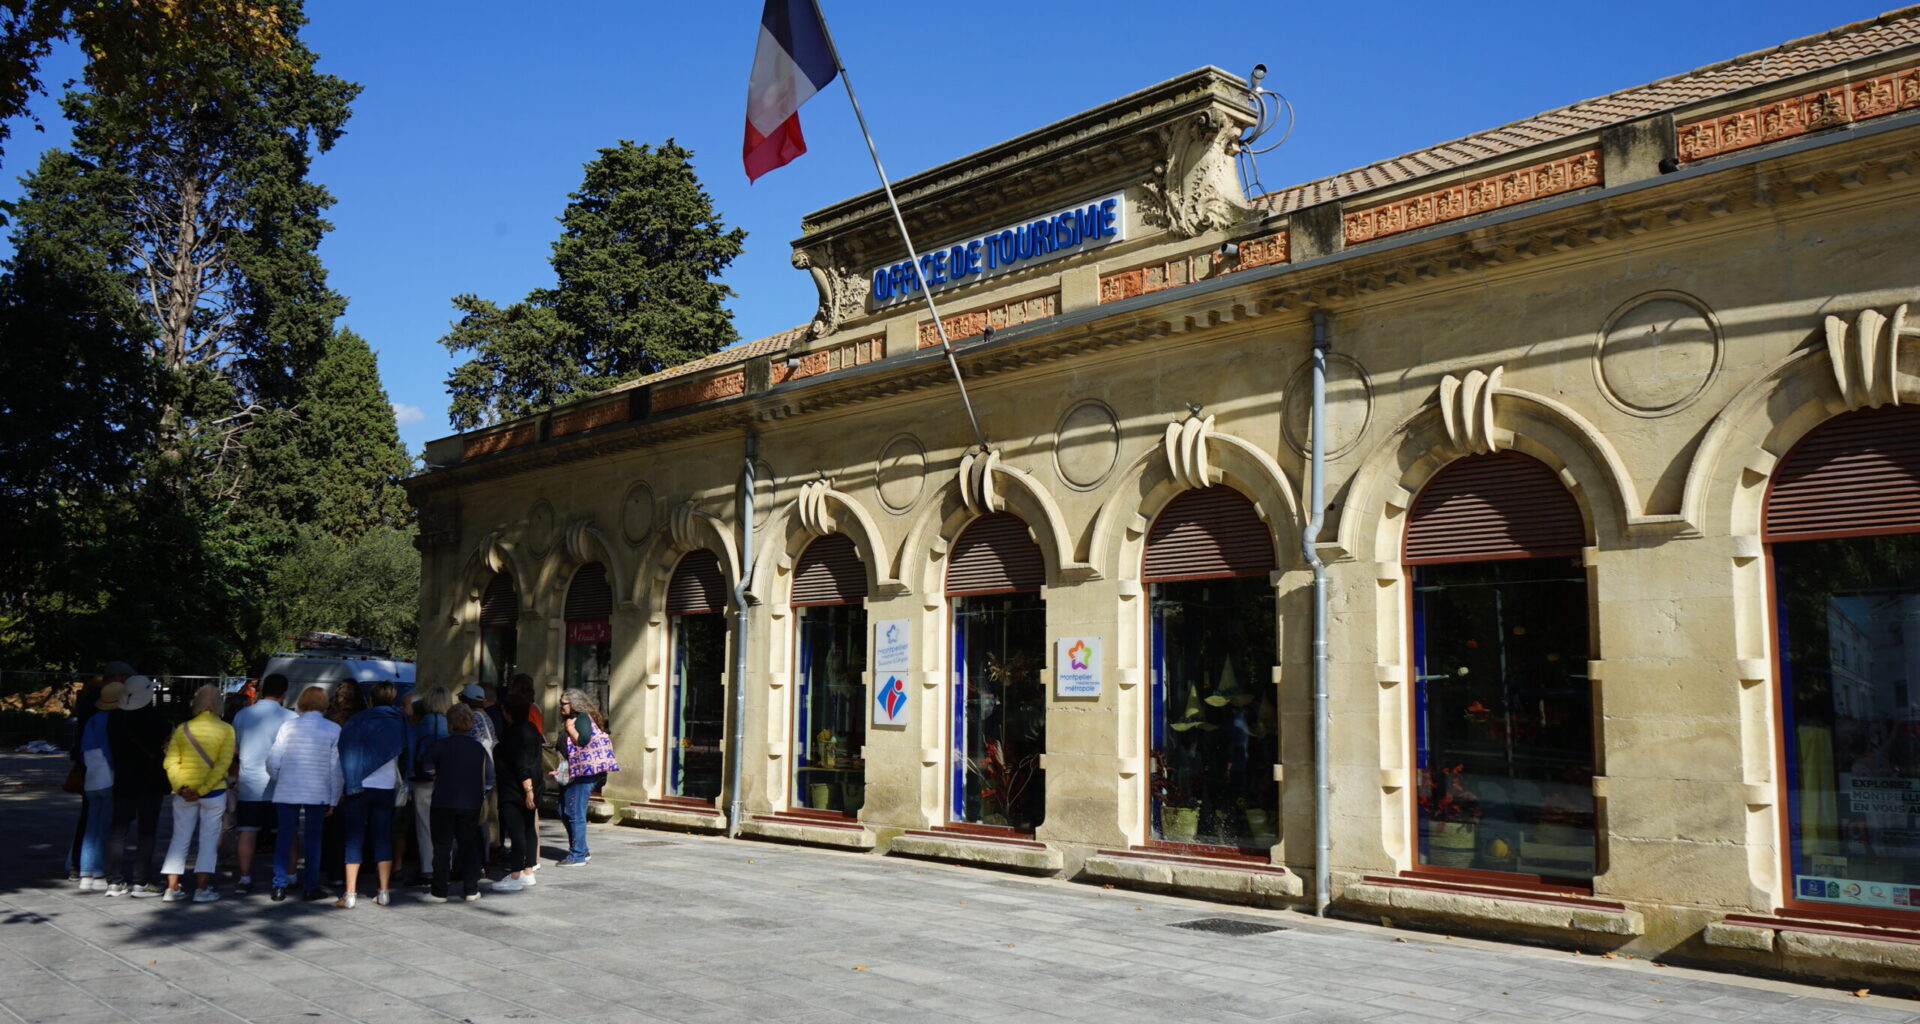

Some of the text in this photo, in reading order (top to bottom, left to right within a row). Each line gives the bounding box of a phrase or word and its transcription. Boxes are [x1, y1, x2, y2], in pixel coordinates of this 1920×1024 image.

[873, 199, 1118, 300] OFFICE DE TOURISME
[1852, 779, 1913, 790] EXPLOREZ
[1854, 803, 1869, 811] EN
[1872, 804, 1905, 813] VOUS
